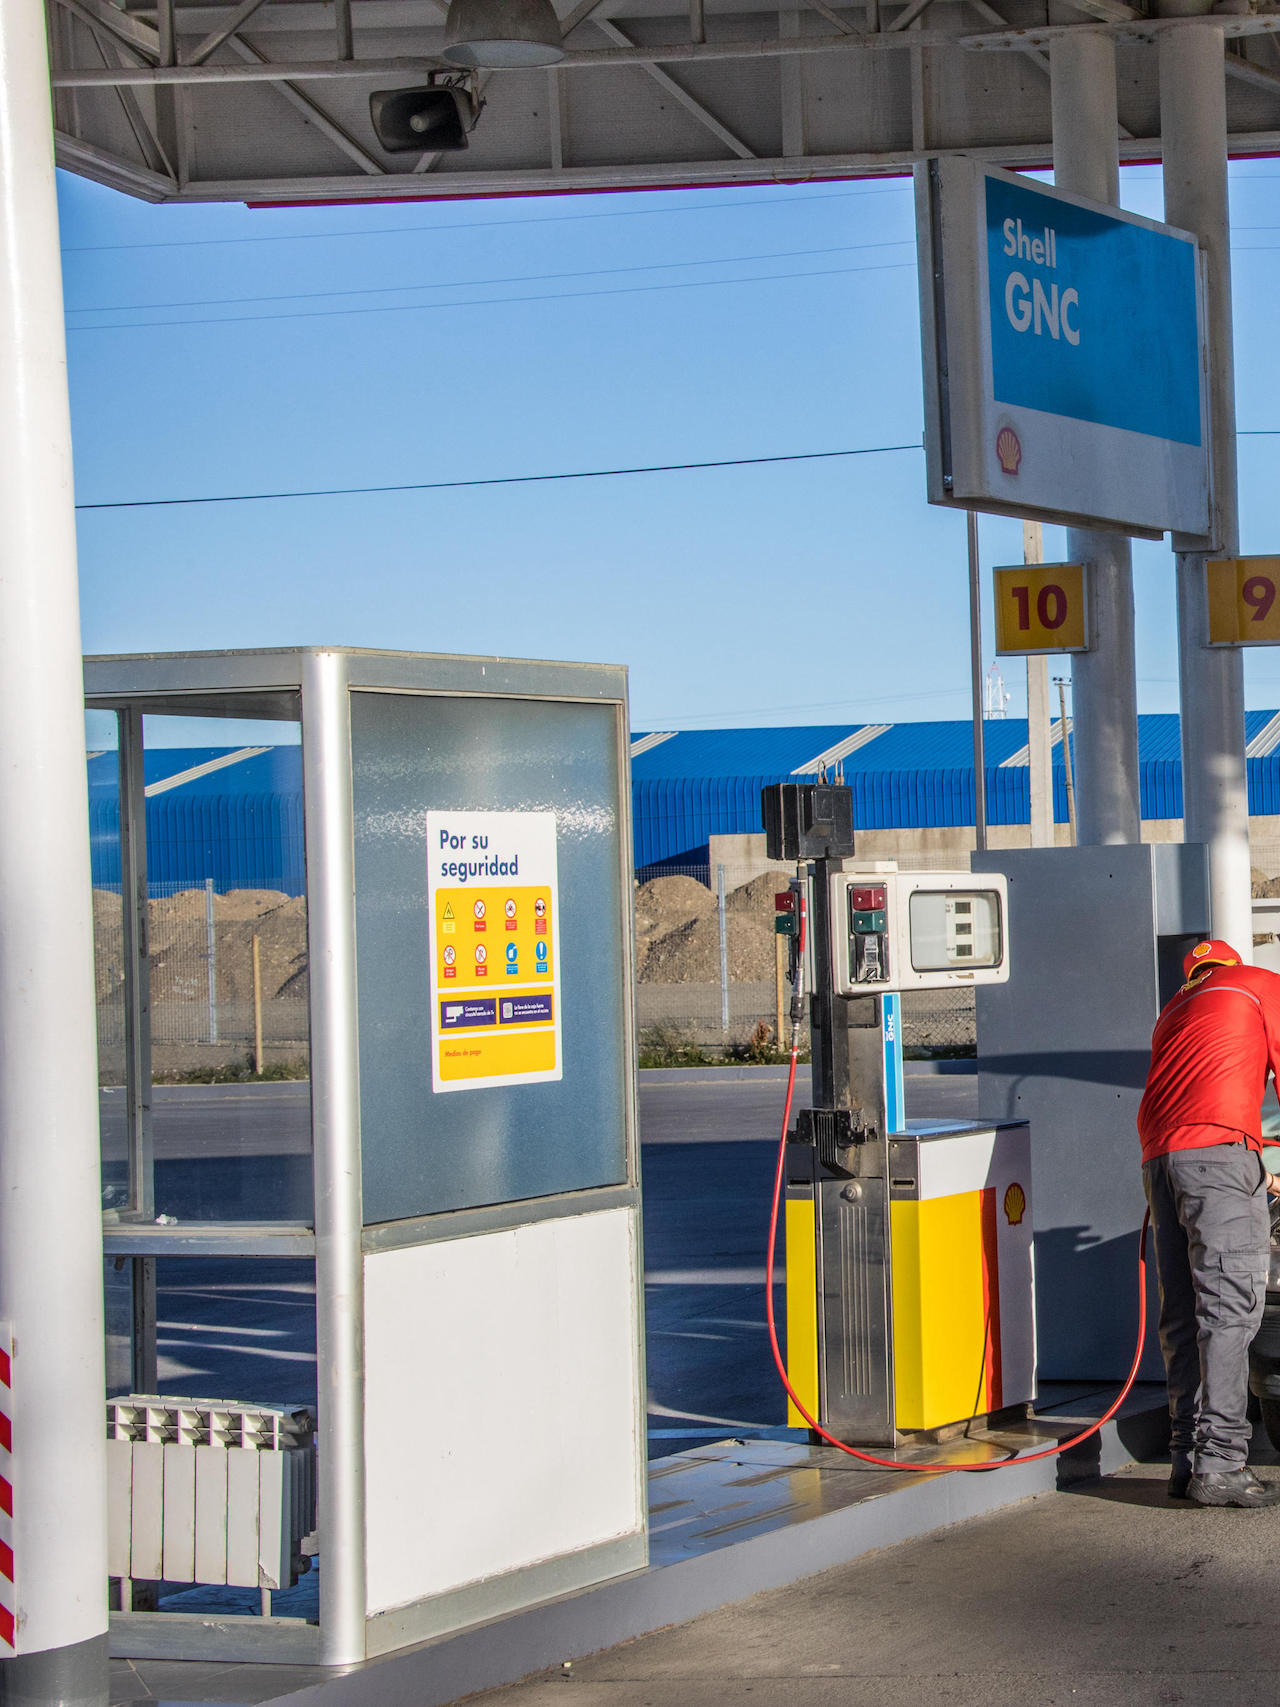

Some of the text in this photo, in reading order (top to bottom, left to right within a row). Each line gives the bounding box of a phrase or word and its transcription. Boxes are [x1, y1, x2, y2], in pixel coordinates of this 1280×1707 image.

[1003, 217, 1056, 269] Shell
[1005, 271, 1080, 346] GNC
[1012, 584, 1067, 631] 10
[1242, 576, 1276, 621] 9
[440, 829, 488, 849] Por su
[441, 854, 518, 882] seguridad
